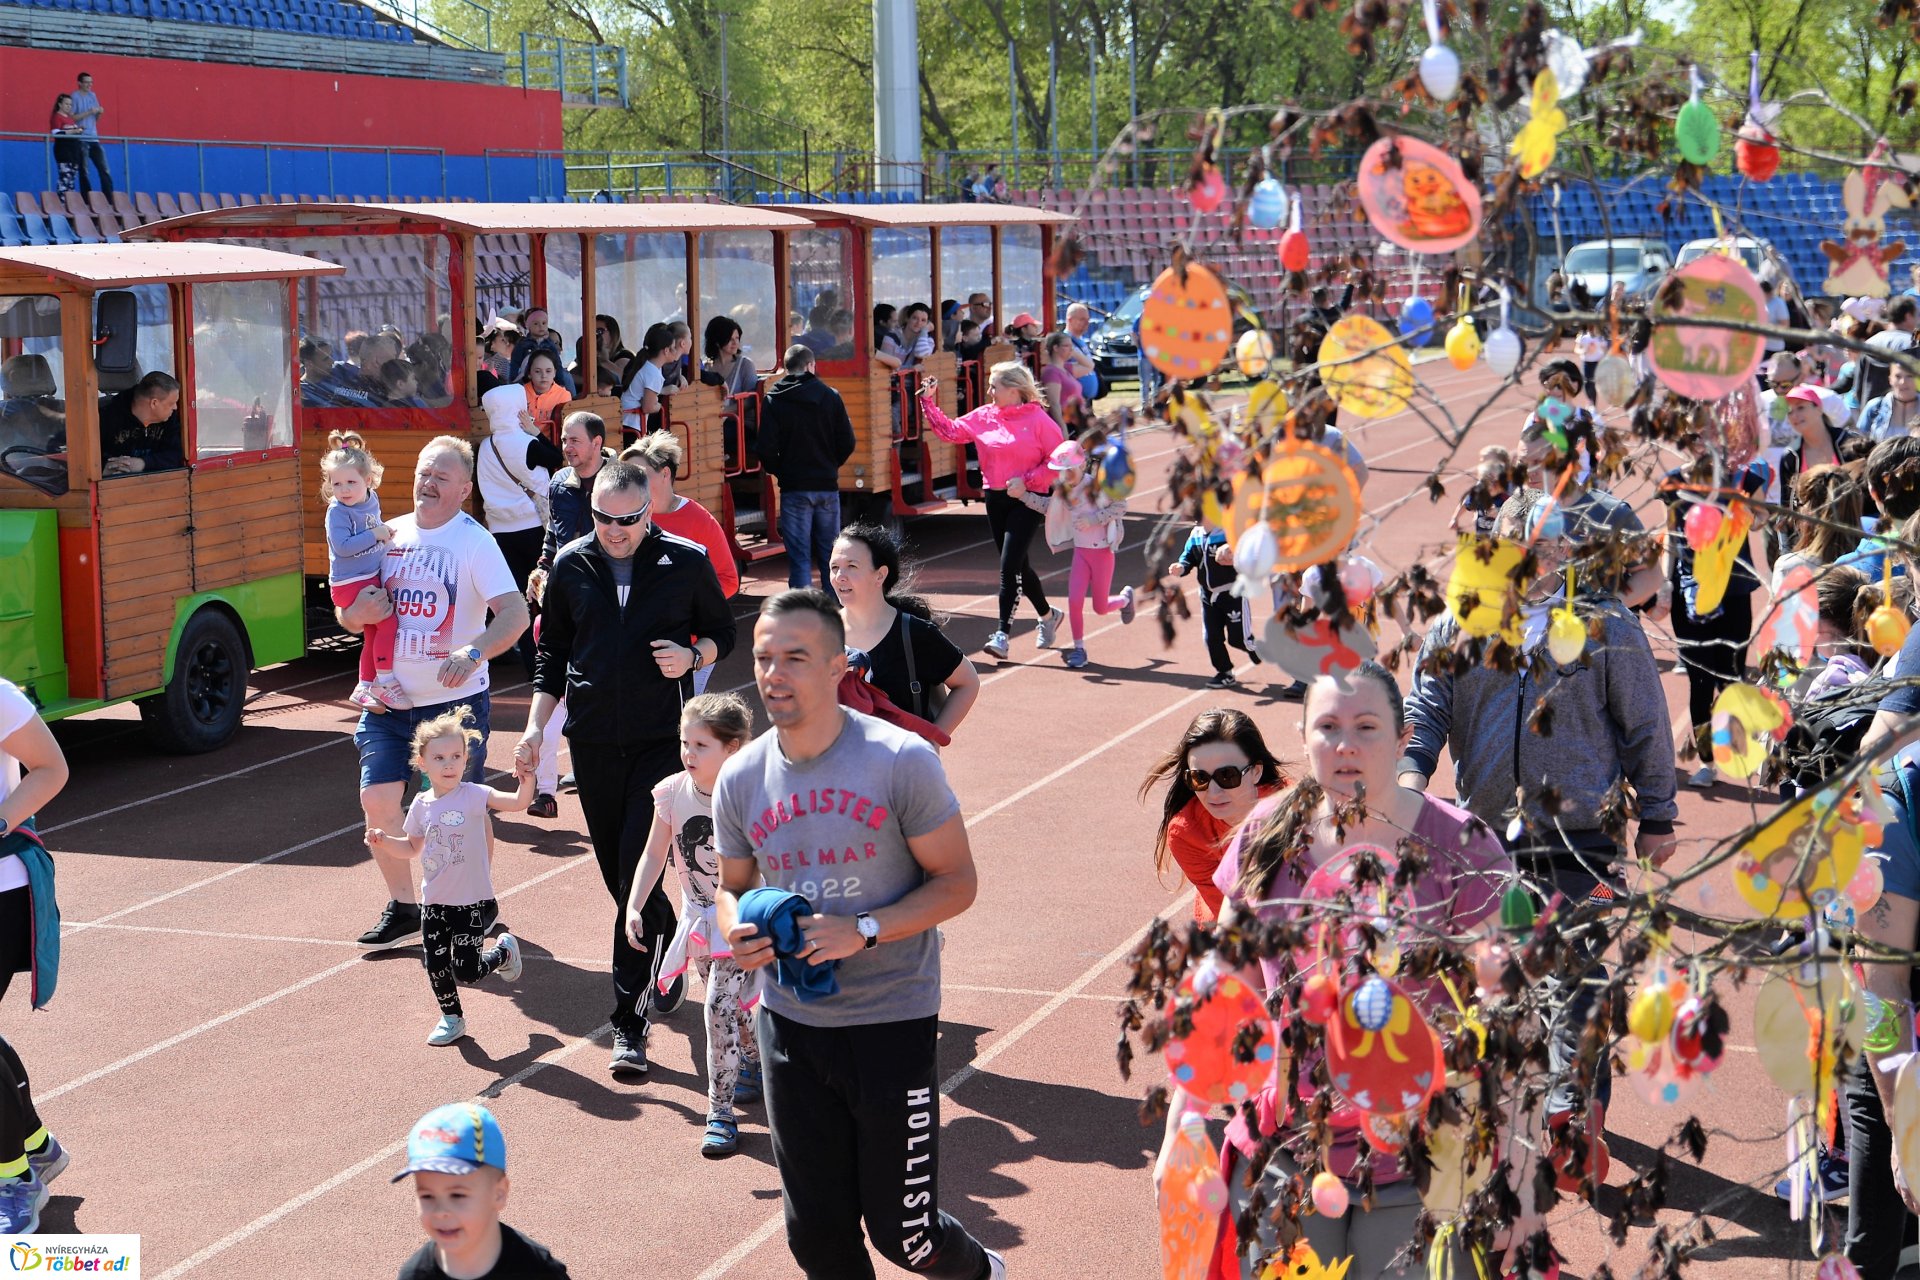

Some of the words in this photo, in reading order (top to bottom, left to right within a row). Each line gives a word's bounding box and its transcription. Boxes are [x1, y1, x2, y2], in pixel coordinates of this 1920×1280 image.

[393, 588, 437, 618] 1993
[749, 788, 888, 848] HOLLISTER
[767, 850, 811, 871] DEL
[818, 841, 877, 865] MAR
[789, 876, 862, 901] 1922
[902, 1086, 933, 1266] HOLLISTER
